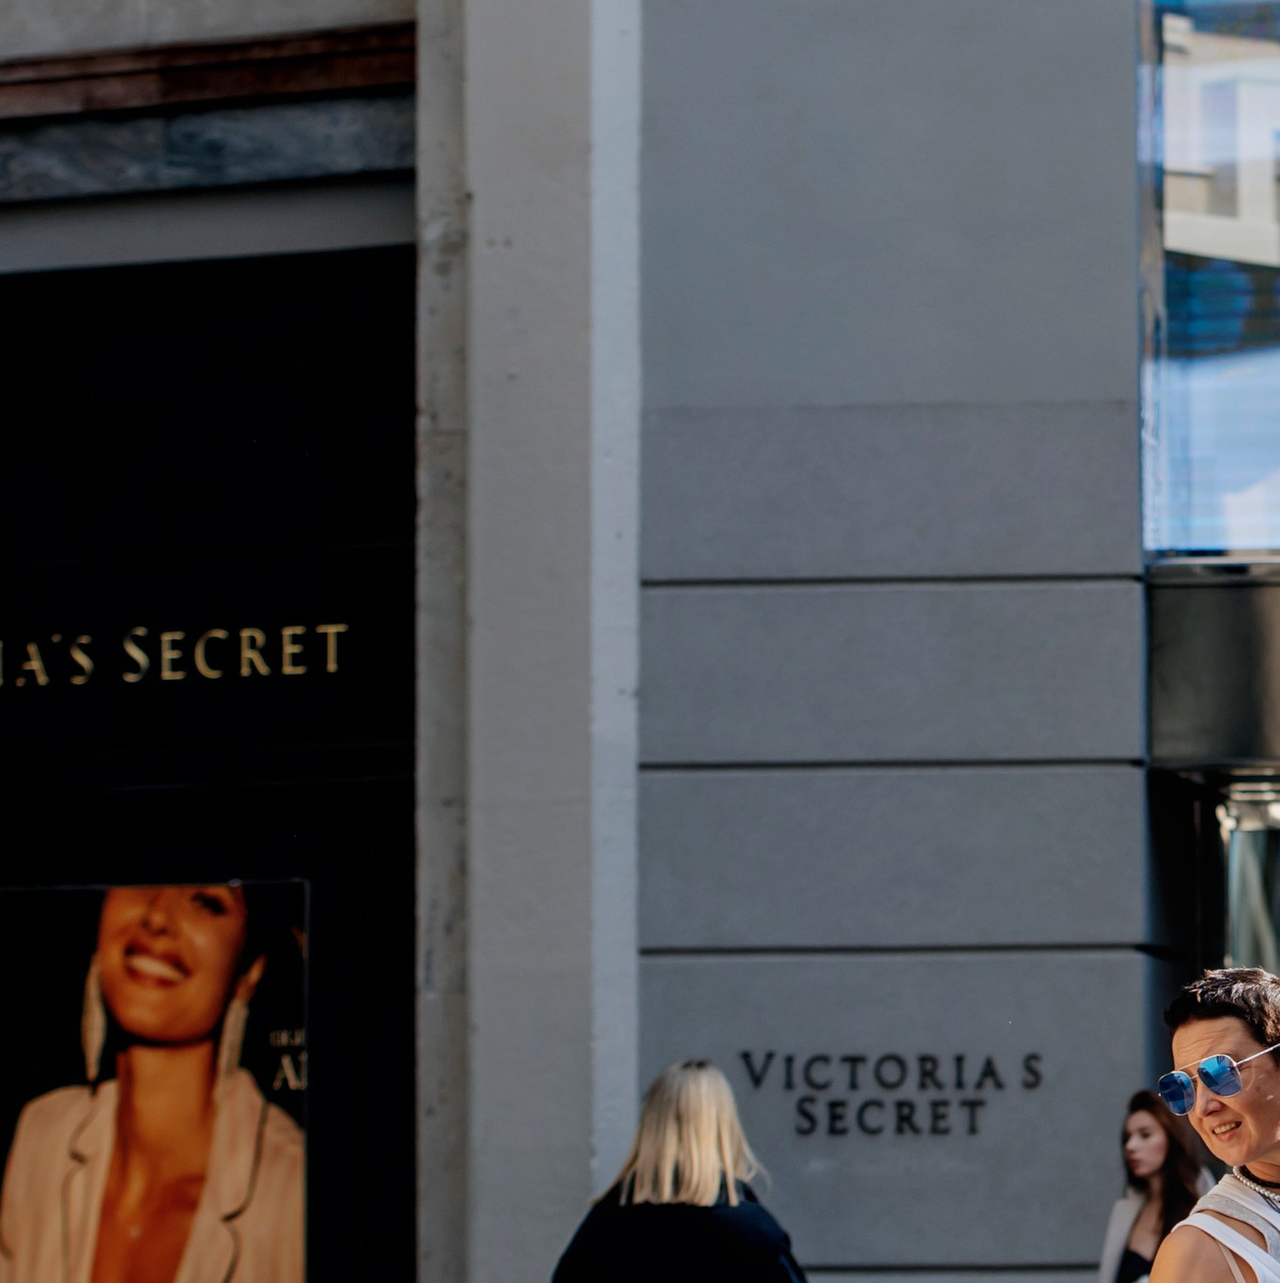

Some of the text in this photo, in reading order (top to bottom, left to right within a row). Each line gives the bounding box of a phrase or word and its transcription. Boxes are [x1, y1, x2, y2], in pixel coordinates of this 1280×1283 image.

[0, 623, 349, 687] A'S SECRET
[794, 1096, 987, 1137] SECRET
